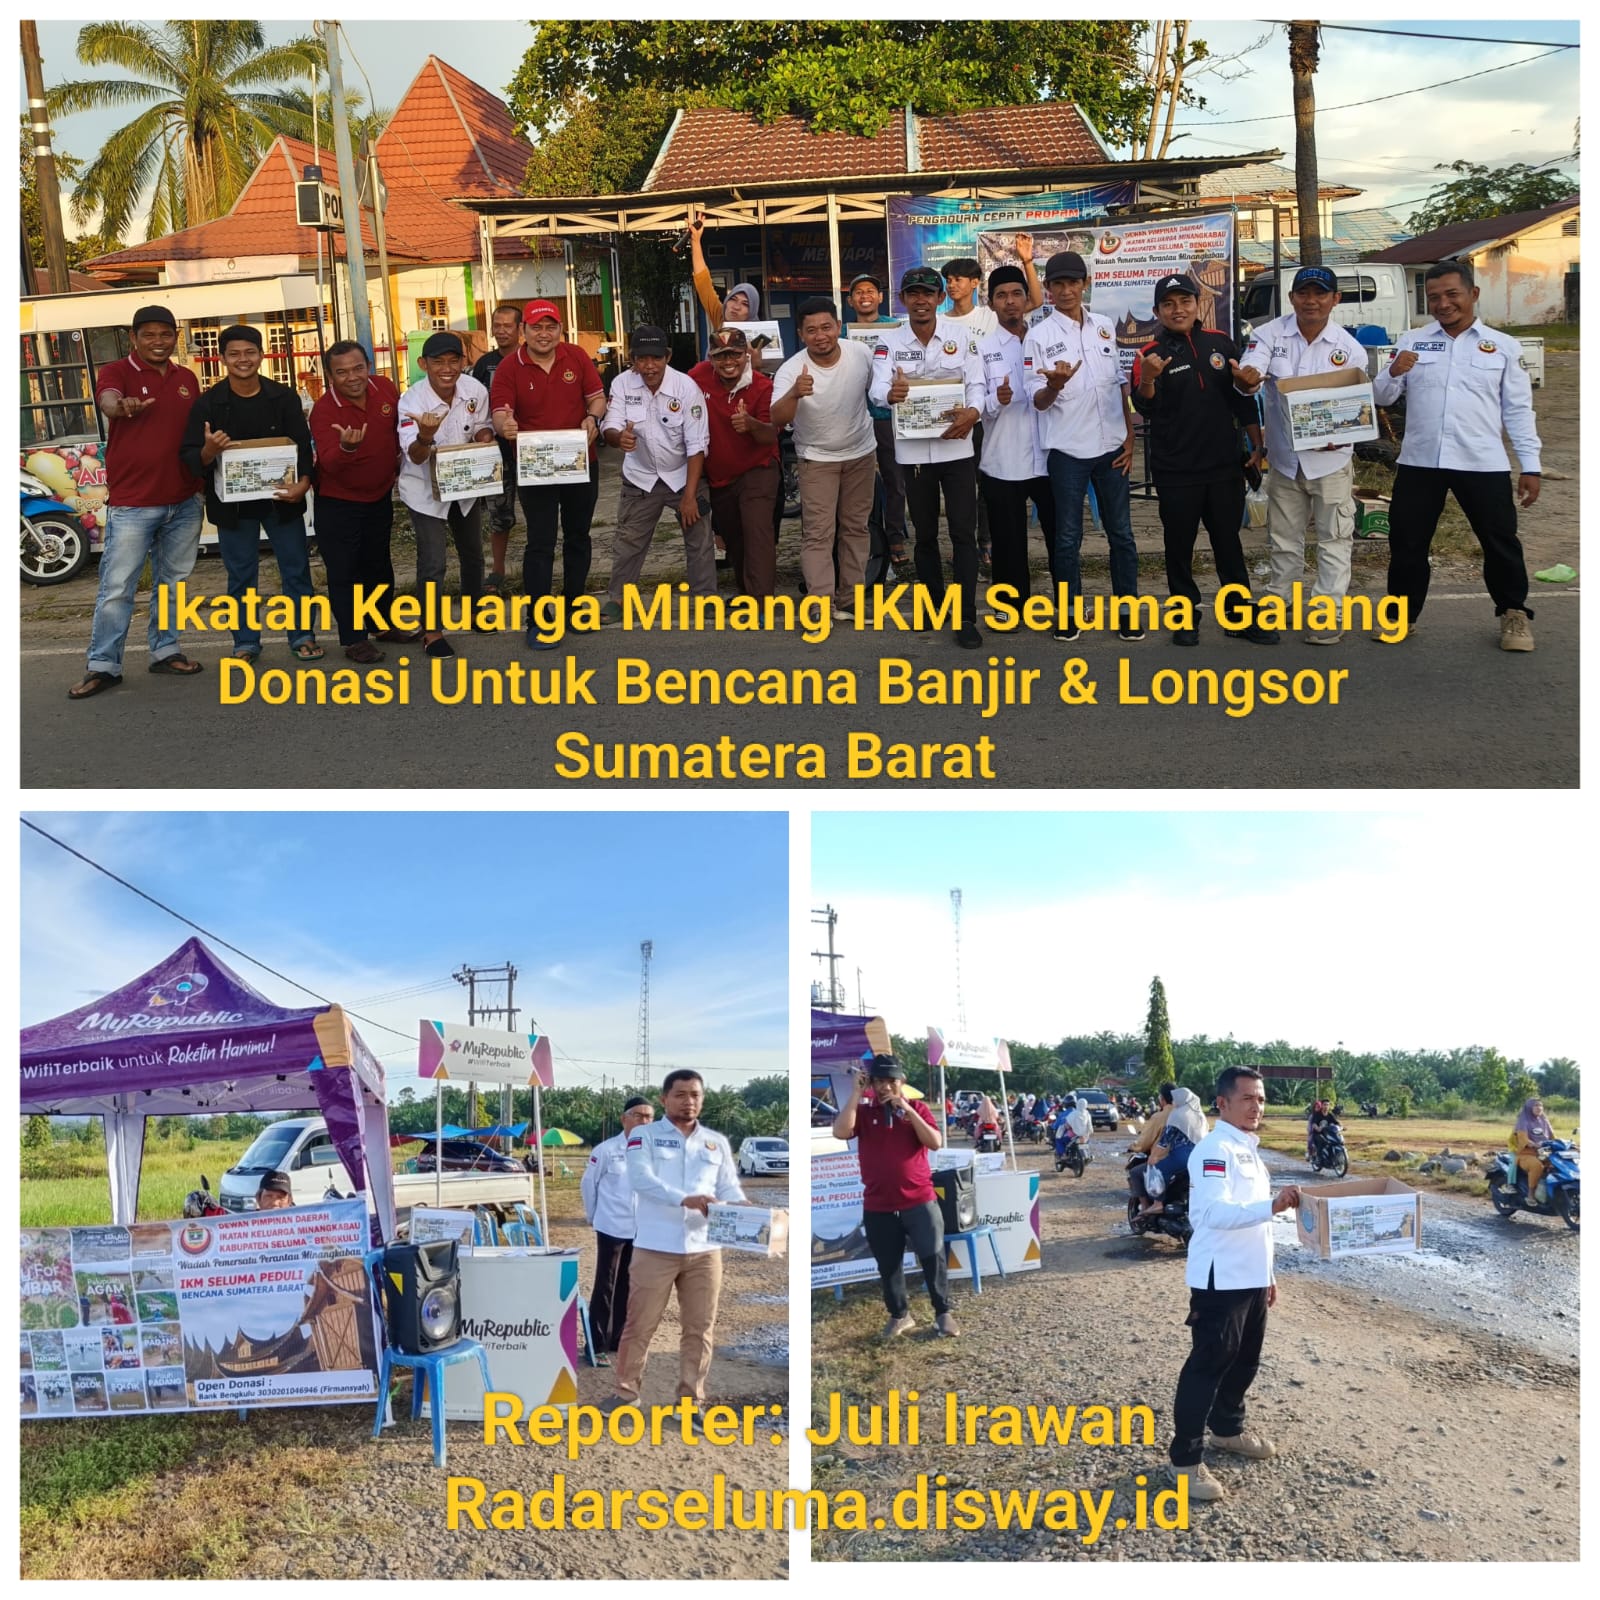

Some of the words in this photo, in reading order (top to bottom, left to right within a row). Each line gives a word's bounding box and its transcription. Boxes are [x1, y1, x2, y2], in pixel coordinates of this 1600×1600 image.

[908, 214, 979, 227] PENGADUAN
[983, 211, 1023, 224] CEPAT
[1026, 208, 1079, 221] PROPAM
[1156, 243, 1184, 251] SELUMA
[1189, 240, 1225, 249] BENGKULU
[1178, 231, 1227, 242] MINANGKABAU
[1095, 271, 1110, 281] IKM
[1111, 269, 1145, 280] SELUMA
[1147, 267, 1180, 278] PEDULI
[1124, 279, 1156, 288] SUMATERA
[77, 1011, 243, 1031] MyRepublic
[20, 1056, 114, 1080] WifiTerbaik
[118, 1050, 165, 1071] untuk
[167, 1041, 216, 1068] Roketin
[219, 1034, 276, 1062] Harimu!
[462, 1040, 527, 1062] MyRepublic
[218, 1220, 250, 1231] DEWAN
[251, 1216, 294, 1228] PIMPINAN
[295, 1212, 331, 1224] DAERAH
[976, 1211, 1025, 1227] yRepublic
[219, 1231, 250, 1242] IKATAN
[250, 1227, 296, 1240] KELUARGA
[297, 1221, 362, 1237] MINANGKABAU
[219, 1241, 270, 1254] KABUPATEN
[270, 1238, 308, 1250] SELUMA
[314, 1233, 361, 1248] BENGKULU
[177, 1259, 211, 1272] Wadah
[212, 1256, 258, 1269] Pemersatu
[258, 1252, 301, 1267] Perantau
[301, 1246, 363, 1264] Minangkabau
[86, 1283, 125, 1296] AGAM
[180, 1277, 204, 1291] IKM
[207, 1273, 256, 1288] SELUMA
[259, 1269, 305, 1284] PEDULI
[182, 1288, 224, 1302] BENCANA
[225, 1285, 275, 1299] SUMATERA
[276, 1283, 306, 1295] BARAT
[461, 1318, 551, 1342] MyRepublic
[197, 1381, 225, 1393] Open
[228, 1377, 266, 1390] Donasi
[198, 1391, 218, 1401] Bank
[220, 1389, 255, 1401] Bengkulu
[320, 1382, 371, 1396] (Firmansyah)
